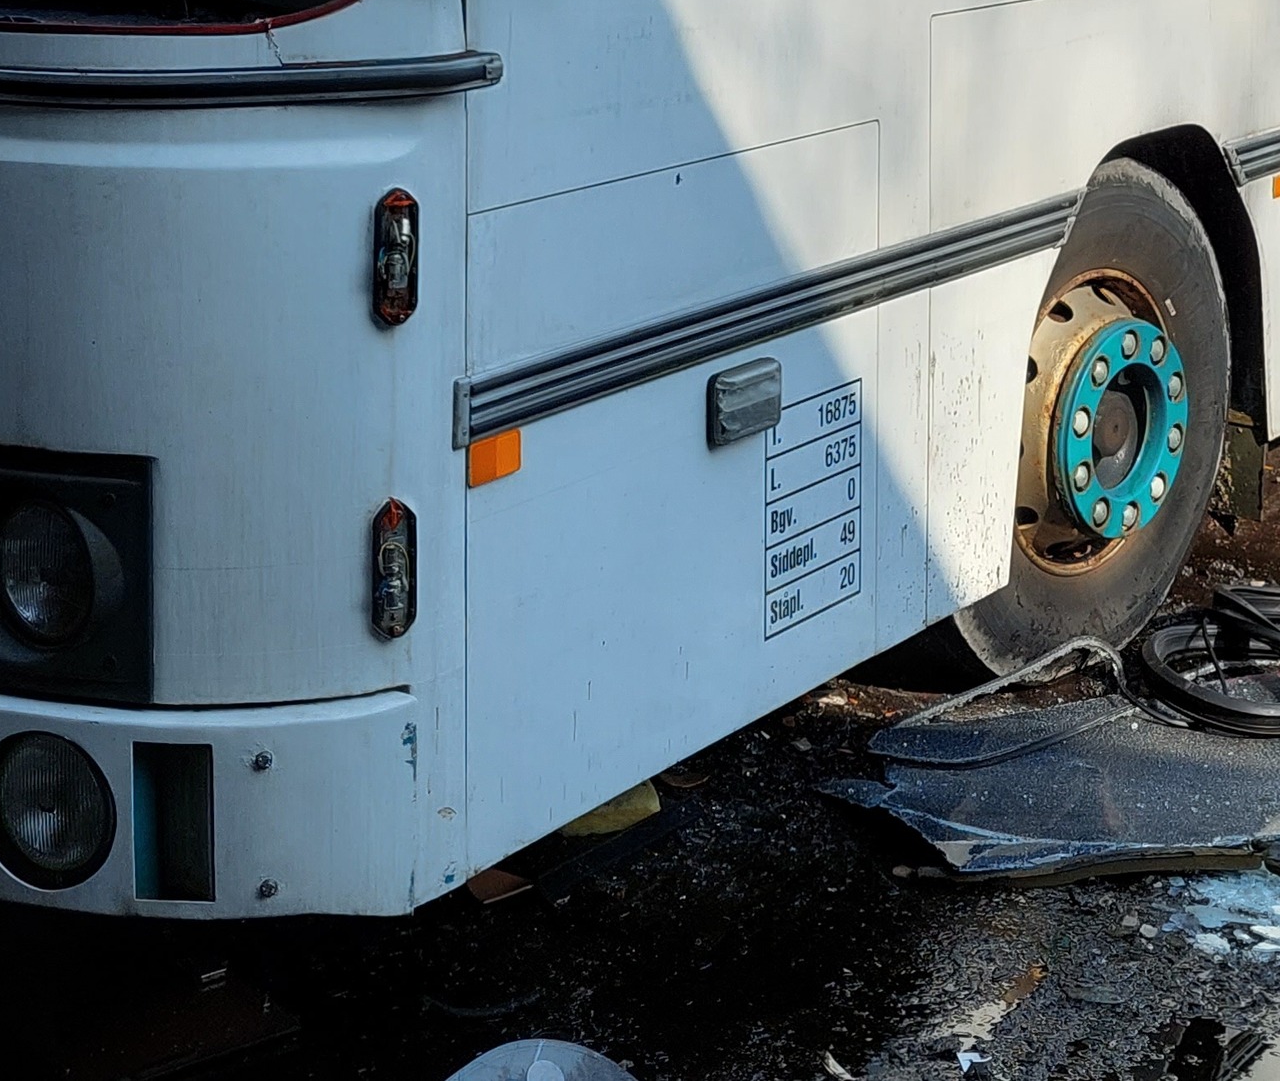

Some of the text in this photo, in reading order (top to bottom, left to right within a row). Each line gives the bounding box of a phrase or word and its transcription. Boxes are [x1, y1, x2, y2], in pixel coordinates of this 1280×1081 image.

[818, 392, 856, 427] 16875
[771, 435, 856, 491] L. 6375
[771, 478, 856, 534] Bgv. 0
[770, 520, 856, 578] Siddepl. 49
[770, 563, 855, 624] Ståpl. 20
